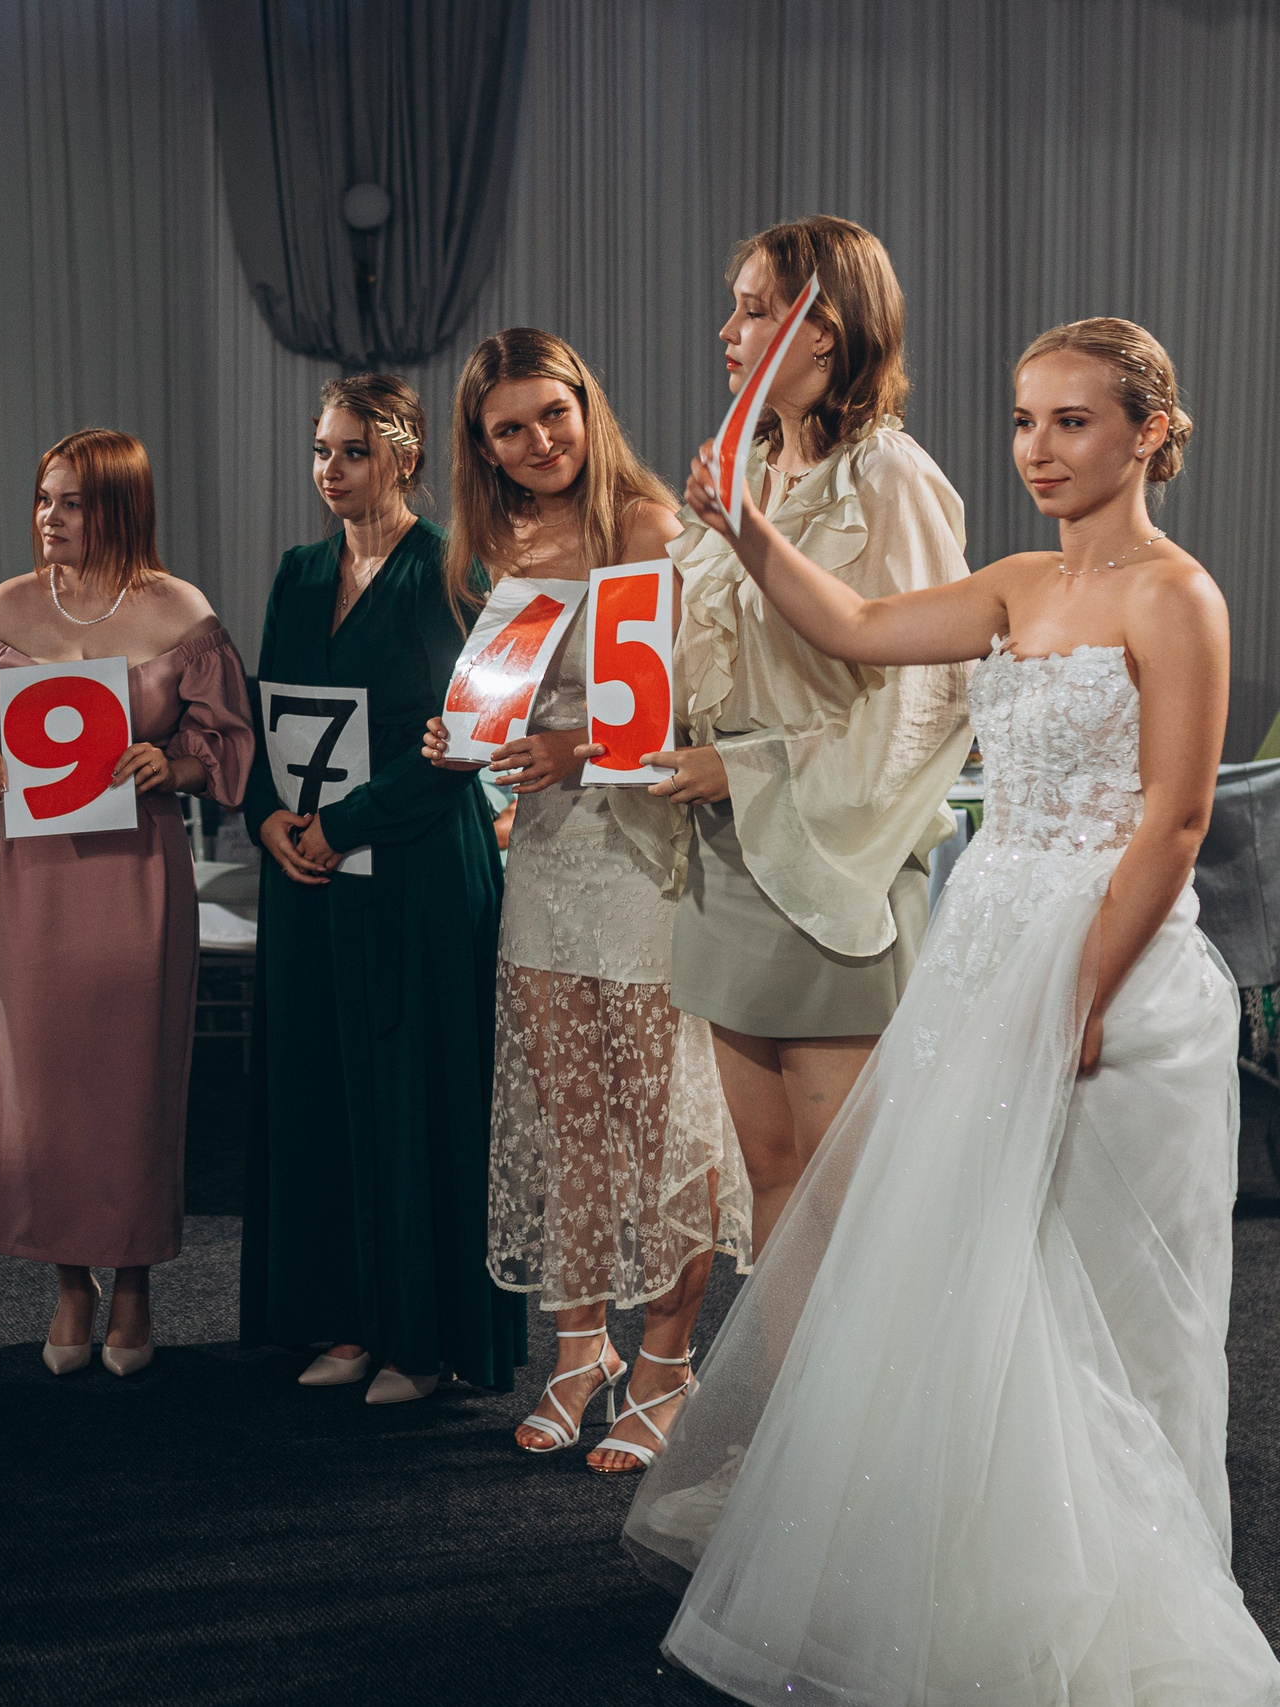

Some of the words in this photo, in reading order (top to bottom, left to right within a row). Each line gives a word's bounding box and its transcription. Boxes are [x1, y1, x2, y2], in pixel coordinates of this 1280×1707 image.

[446, 594, 566, 745] 4
[591, 573, 671, 771] 5
[3, 676, 129, 820] 9
[270, 694, 358, 842] 7
